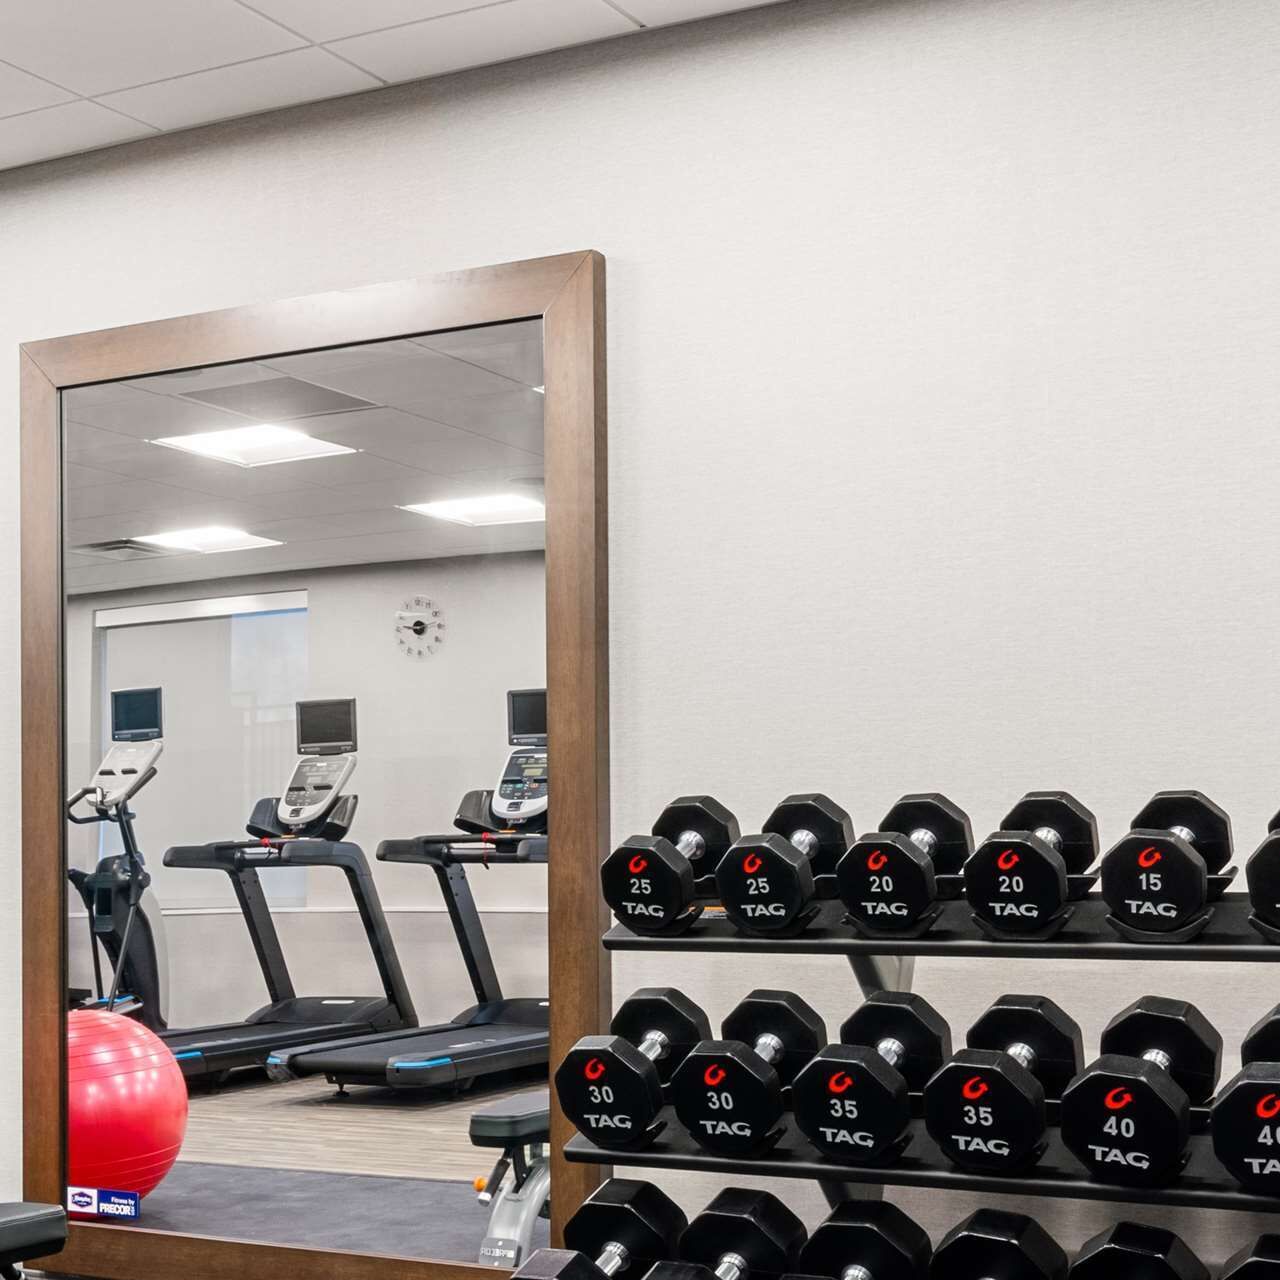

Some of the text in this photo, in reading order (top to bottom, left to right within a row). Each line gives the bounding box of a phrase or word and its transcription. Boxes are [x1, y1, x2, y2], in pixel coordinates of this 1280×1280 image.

[629, 877, 653, 895] 25
[745, 877, 771, 896] 25
[869, 875, 893, 892] 20
[998, 875, 1024, 893] 20
[1139, 872, 1162, 891] 15
[621, 901, 666, 919] TAG
[740, 902, 787, 918] TAG
[861, 902, 908, 916] TAG
[988, 902, 1039, 918] TAG
[1124, 899, 1177, 918] TAG
[588, 1085, 614, 1103] 30
[707, 1091, 733, 1110] 30
[830, 1098, 858, 1119] 35
[963, 1105, 993, 1126] 35
[583, 1114, 633, 1130] TAG
[699, 1120, 752, 1137] TAG
[1103, 1116, 1135, 1138] 40
[819, 1127, 874, 1148] TAG
[951, 1135, 1010, 1156] TAG
[1087, 1144, 1150, 1170] TAG
[99, 1202, 131, 1216] PRECOR
